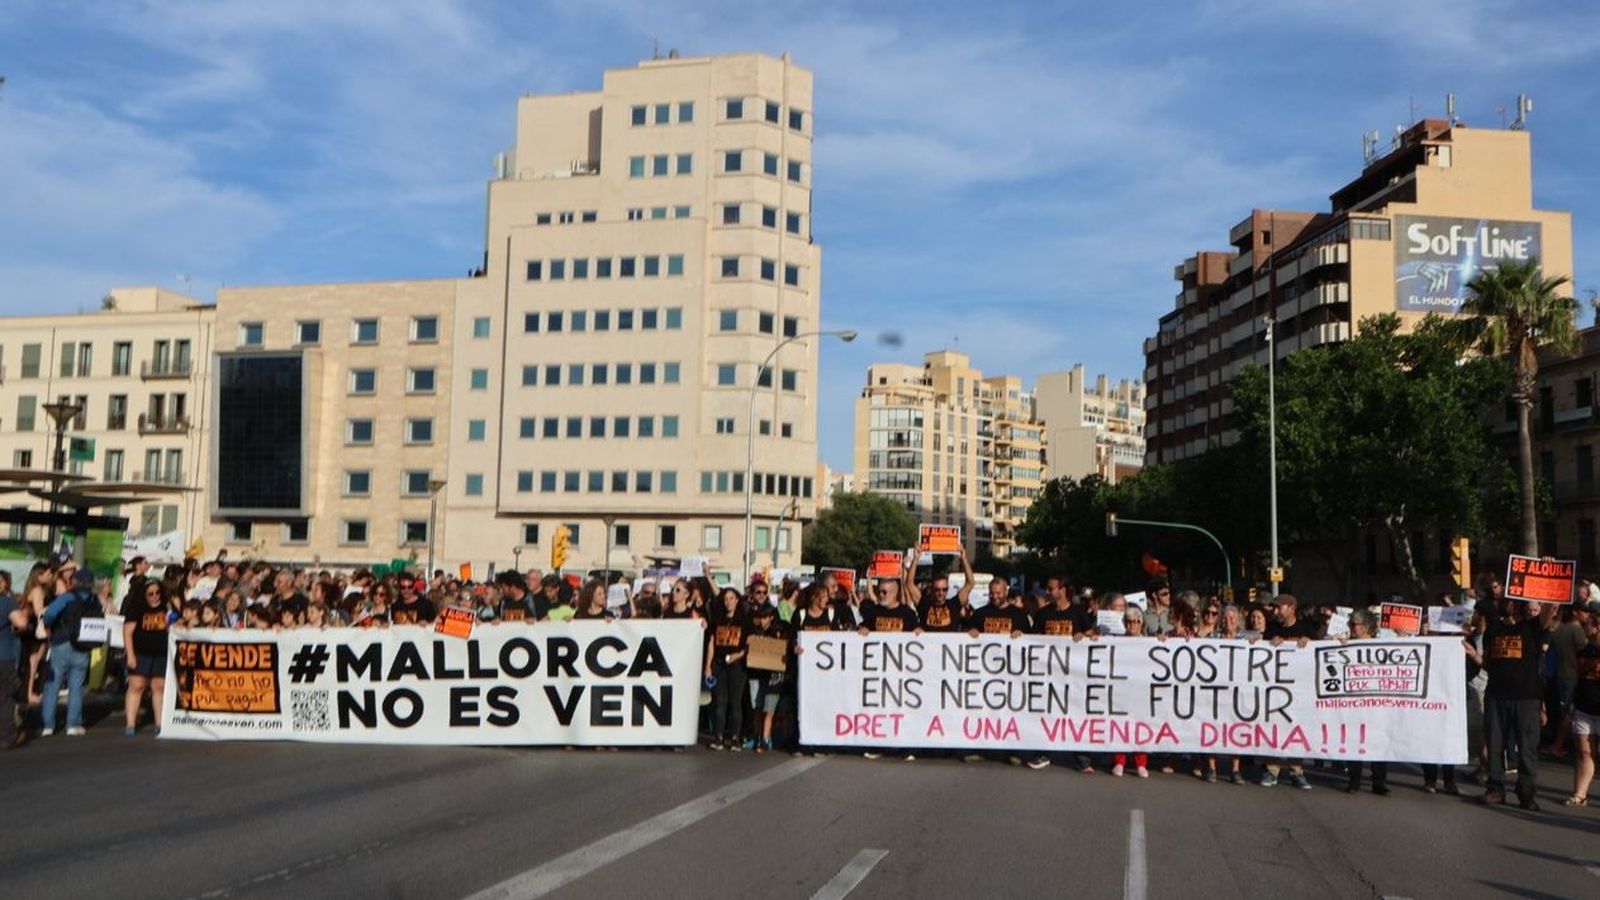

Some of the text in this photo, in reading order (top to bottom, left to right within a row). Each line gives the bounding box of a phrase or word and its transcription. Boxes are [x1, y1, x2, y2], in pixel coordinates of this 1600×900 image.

[1409, 295, 1421, 304] EL
[1422, 296, 1460, 306] MUNDO
[1512, 559, 1572, 577] SE ALQUILA
[1392, 607, 1420, 617] ALQUILA
[178, 642, 272, 669] SE VENDE
[288, 636, 673, 684] #MALLORCA
[815, 641, 1296, 684] SI ENS NEGUEN EL SOSTRE
[1323, 650, 1351, 665] ES
[1377, 668, 1393, 677] no
[1396, 665, 1413, 677] ho
[227, 676, 245, 688] no
[337, 685, 673, 729] NO ES VEN
[862, 677, 1293, 723] ENS NEGUEN EL FUTUR
[1315, 697, 1448, 711] mallorcanoesven.com
[835, 713, 904, 738] DRET
[926, 715, 945, 738] A
[963, 716, 1021, 741] UNA
[1040, 717, 1180, 745] VIVENDA
